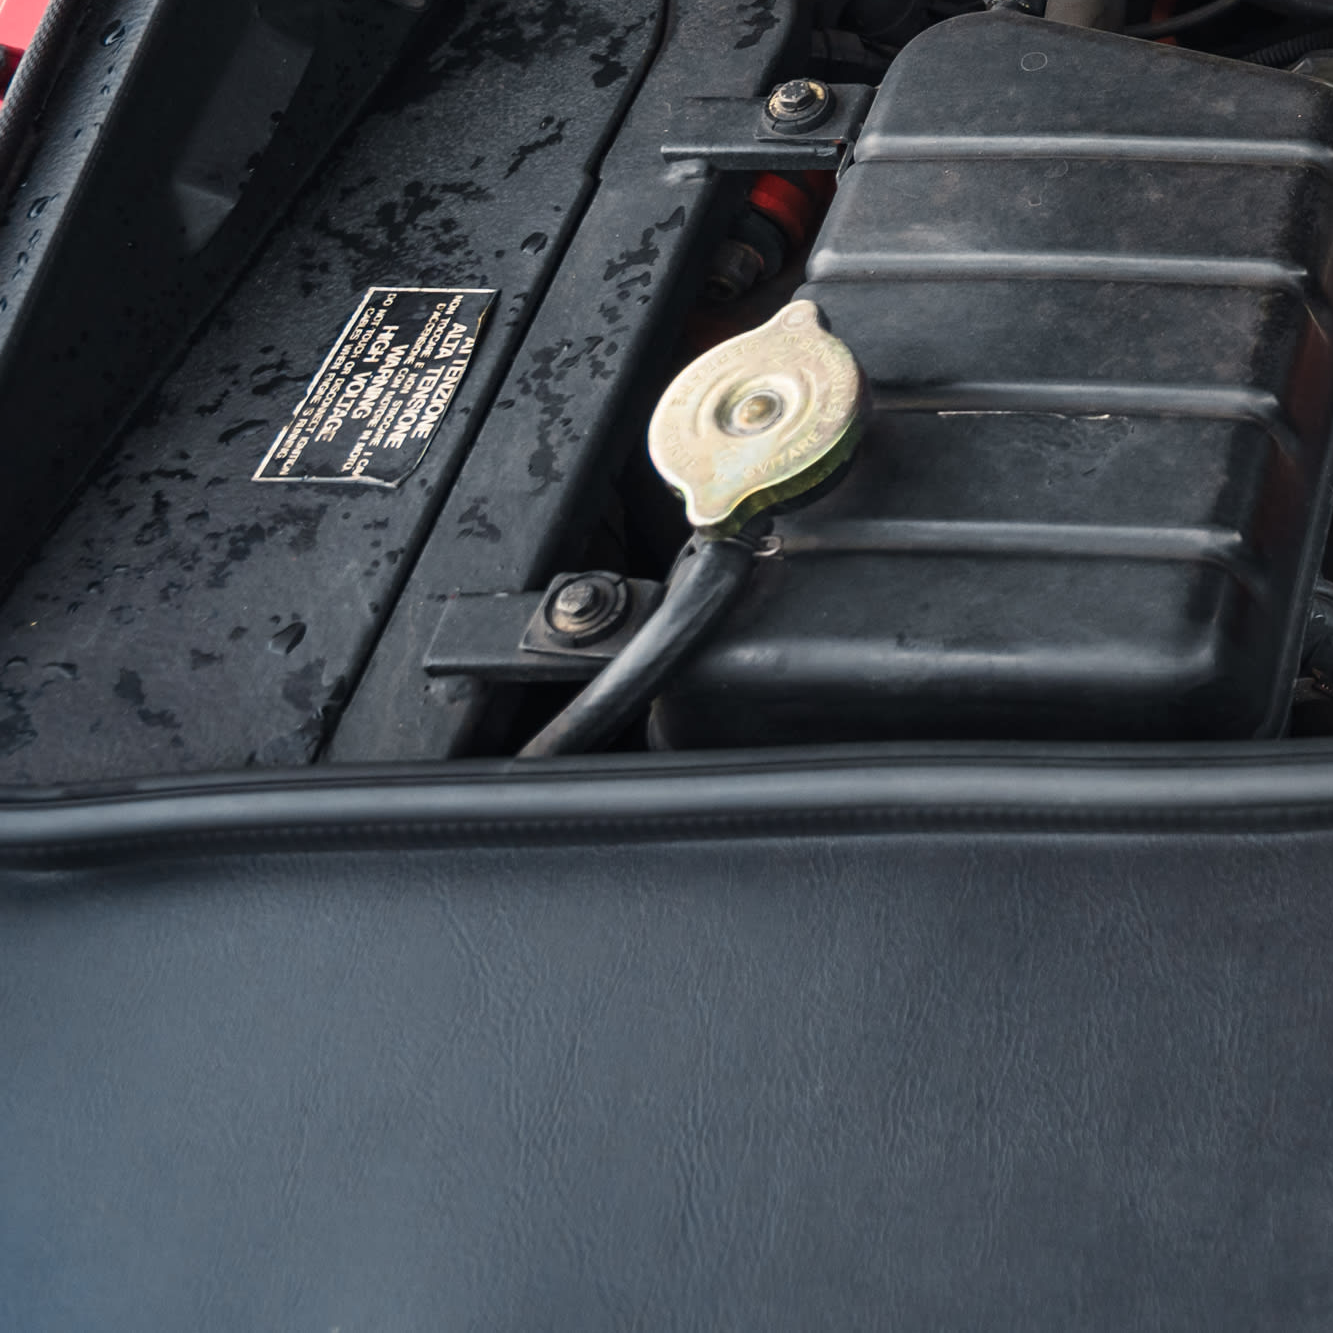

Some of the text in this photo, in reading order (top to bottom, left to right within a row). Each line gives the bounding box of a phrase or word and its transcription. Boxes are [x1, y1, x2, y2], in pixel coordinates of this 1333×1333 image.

[380, 293, 397, 306] DO
[444, 294, 463, 314] NON
[348, 307, 376, 340] CABLES
[369, 309, 387, 325] NOT
[349, 328, 376, 357] TOUCH
[419, 317, 451, 357] TOCCARE
[339, 361, 355, 374] OR
[349, 343, 409, 419] WARNING
[388, 367, 409, 387] CON
[313, 325, 400, 442] HIGH VOLTAGE
[382, 322, 469, 449] ALTA TENSIONE
[303, 378, 345, 433] DISCONNECT
